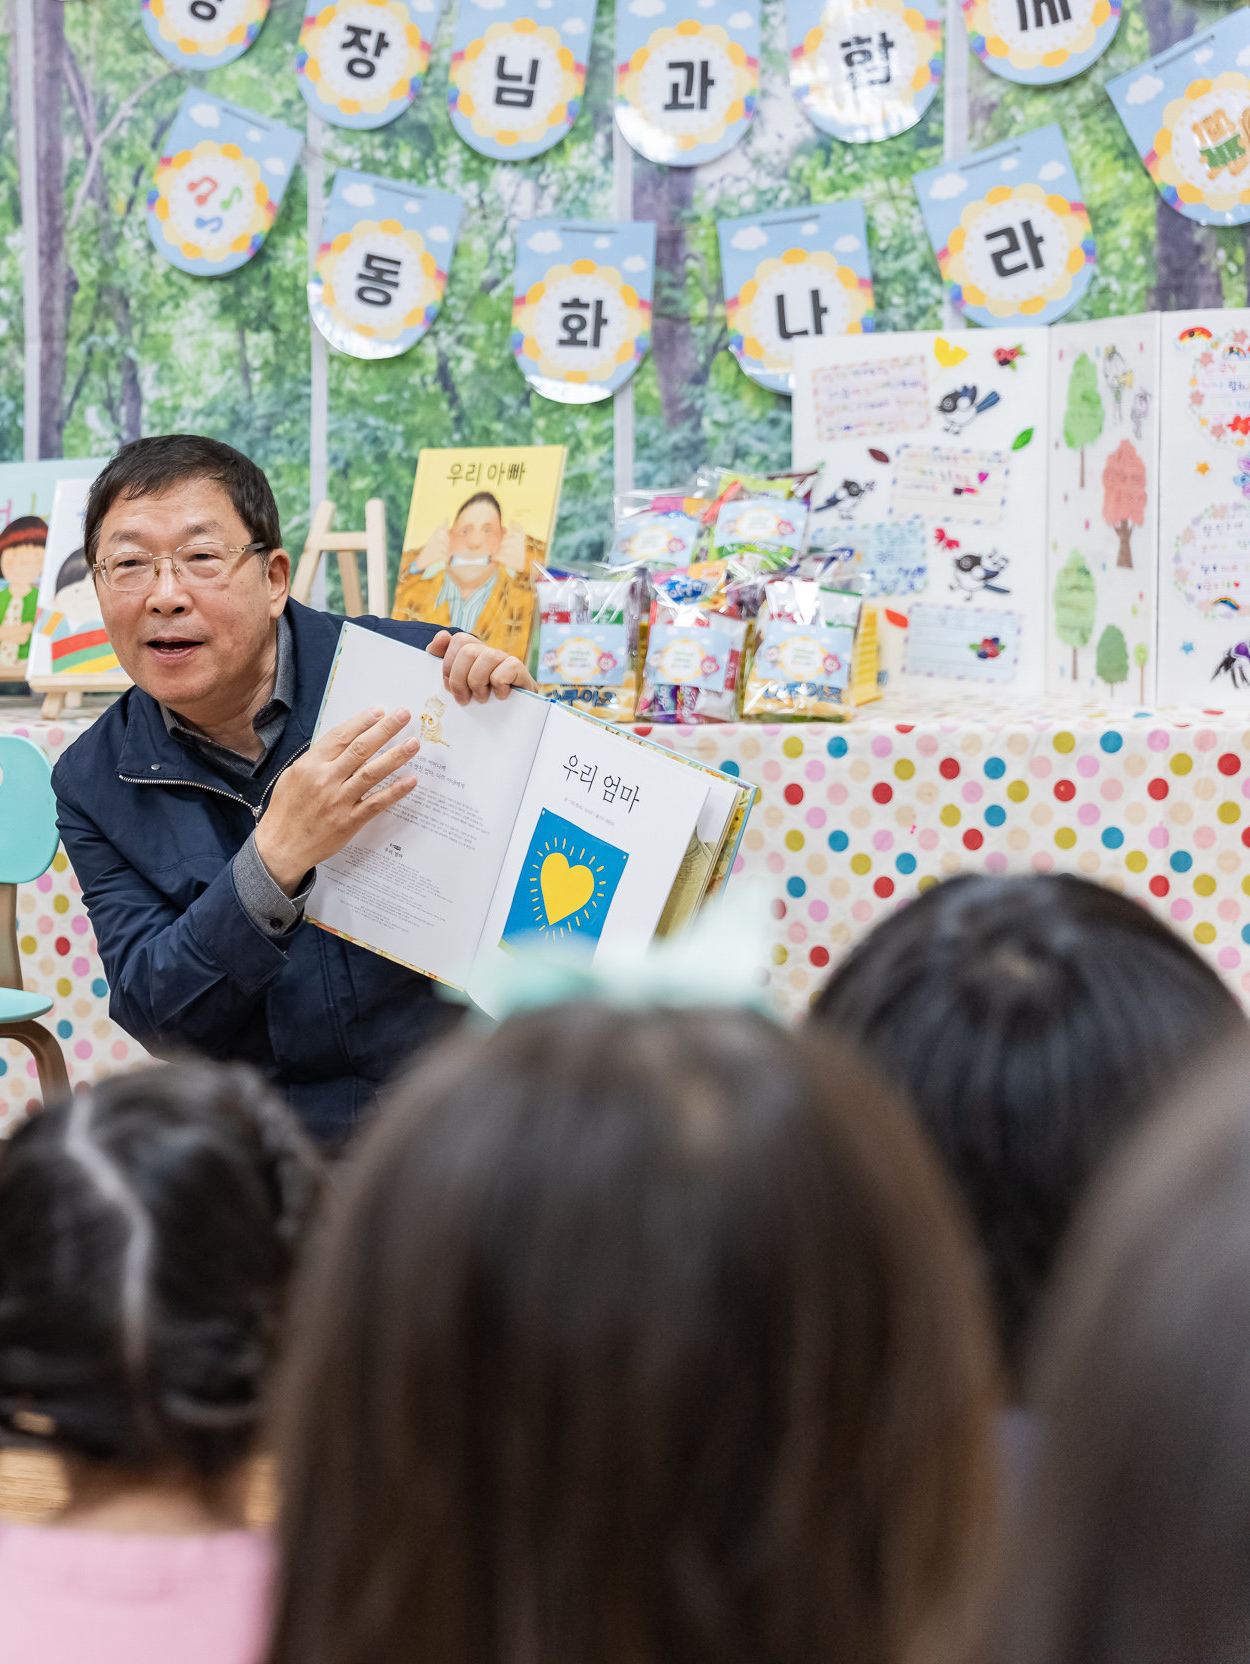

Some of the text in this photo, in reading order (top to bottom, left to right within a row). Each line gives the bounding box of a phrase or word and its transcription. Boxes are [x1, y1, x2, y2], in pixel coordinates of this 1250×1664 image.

[446, 462, 525, 487] 우리 아빠
[562, 755, 598, 793] 우리
[603, 775, 640, 814] 엄마
